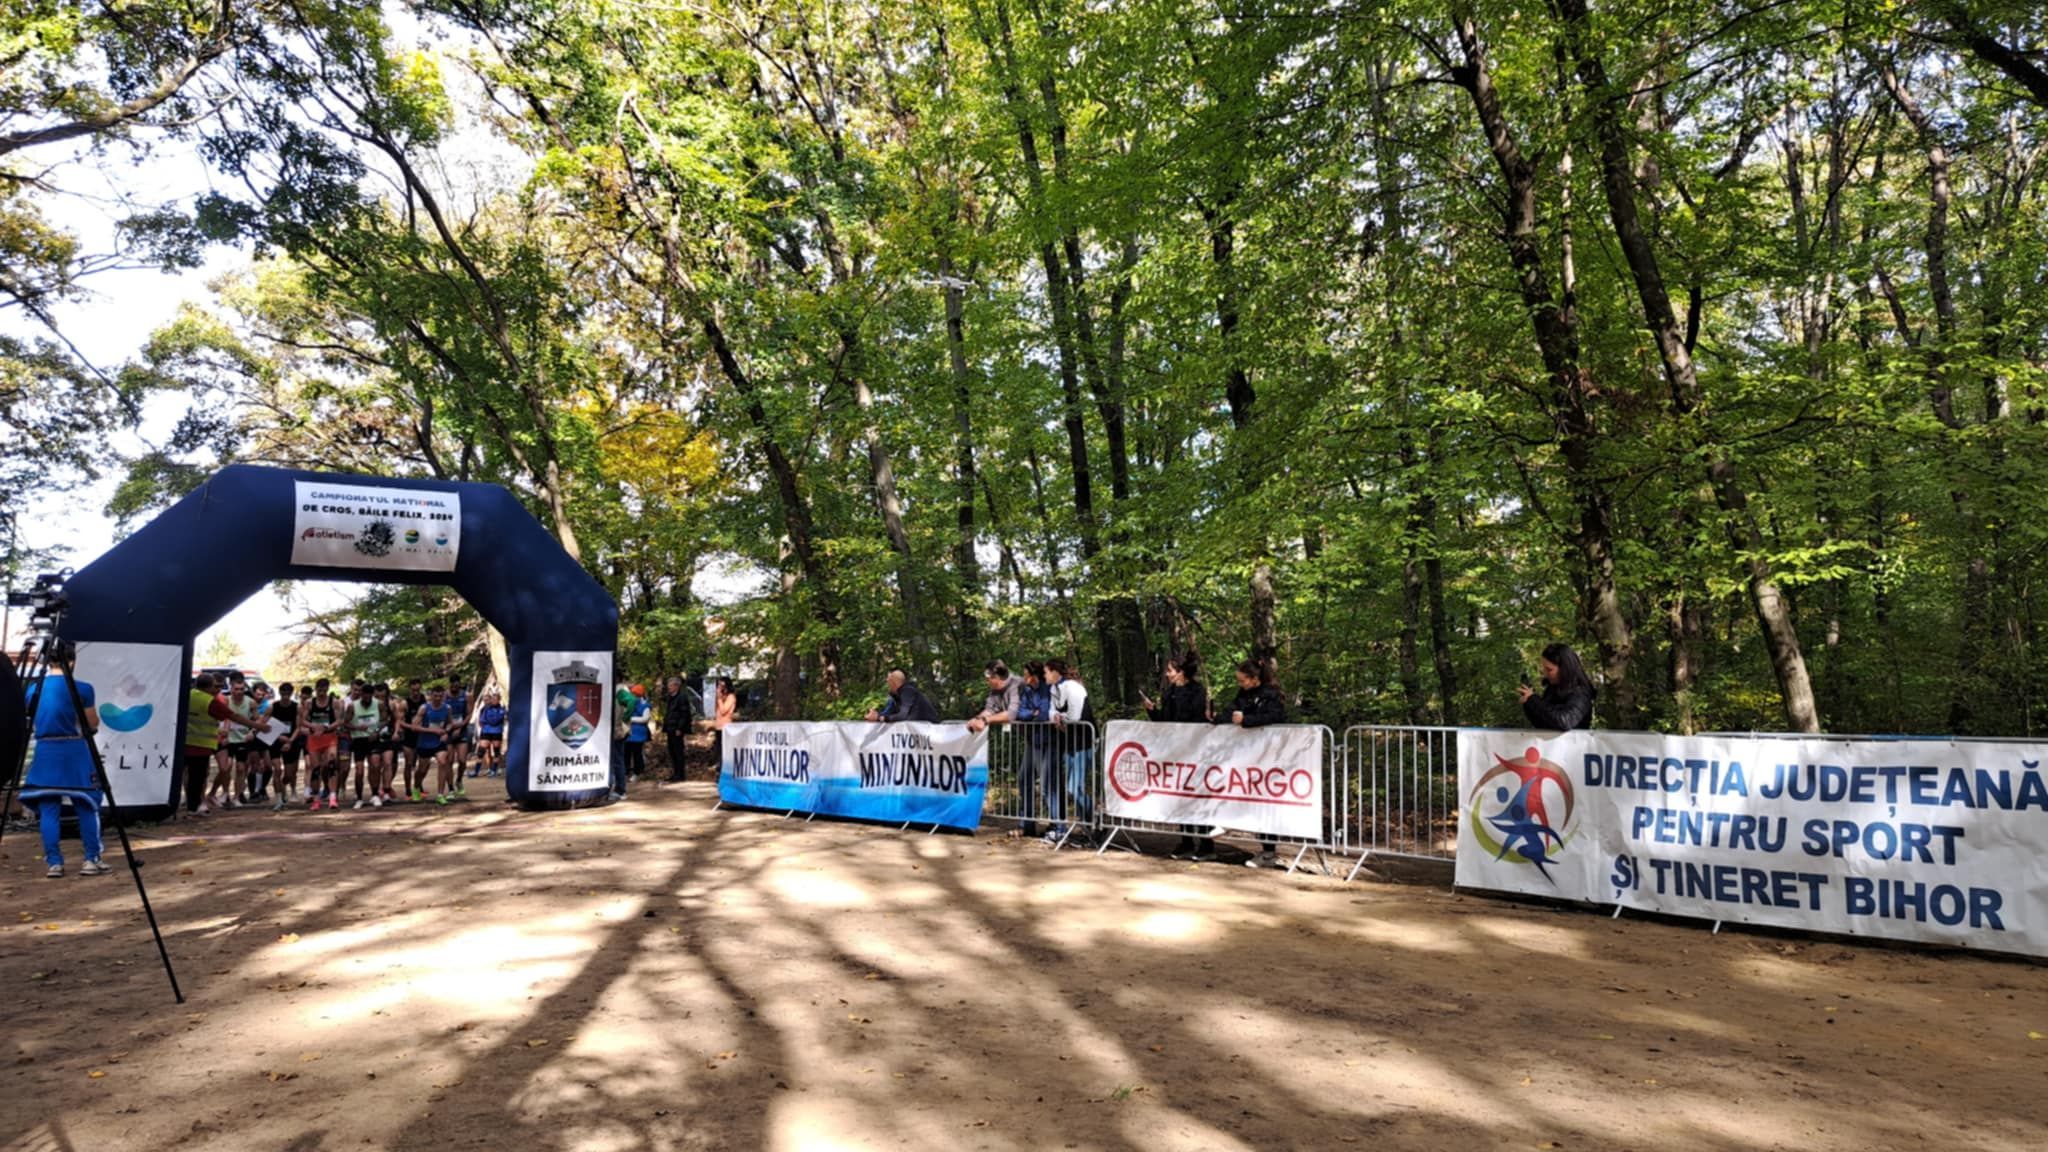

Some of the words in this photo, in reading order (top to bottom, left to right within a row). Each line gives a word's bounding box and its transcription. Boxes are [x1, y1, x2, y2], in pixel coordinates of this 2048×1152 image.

[303, 504, 318, 512] DE
[756, 731, 788, 746] IZVORUL
[545, 753, 600, 767] PRIMĂRIA
[733, 747, 809, 784] MINUNILOR
[859, 752, 967, 795] MINUNILOR
[1204, 765, 1313, 799] CARGO
[1584, 754, 1748, 806] DIRECȚIA
[1760, 760, 2048, 817] JUDEȚEANĂ
[1632, 806, 1787, 853] PENTRU
[1801, 819, 1965, 866] SPORT
[1611, 854, 1640, 899] ȘI
[1649, 858, 1828, 911] TINERET
[1845, 876, 2005, 931] BIHOR
